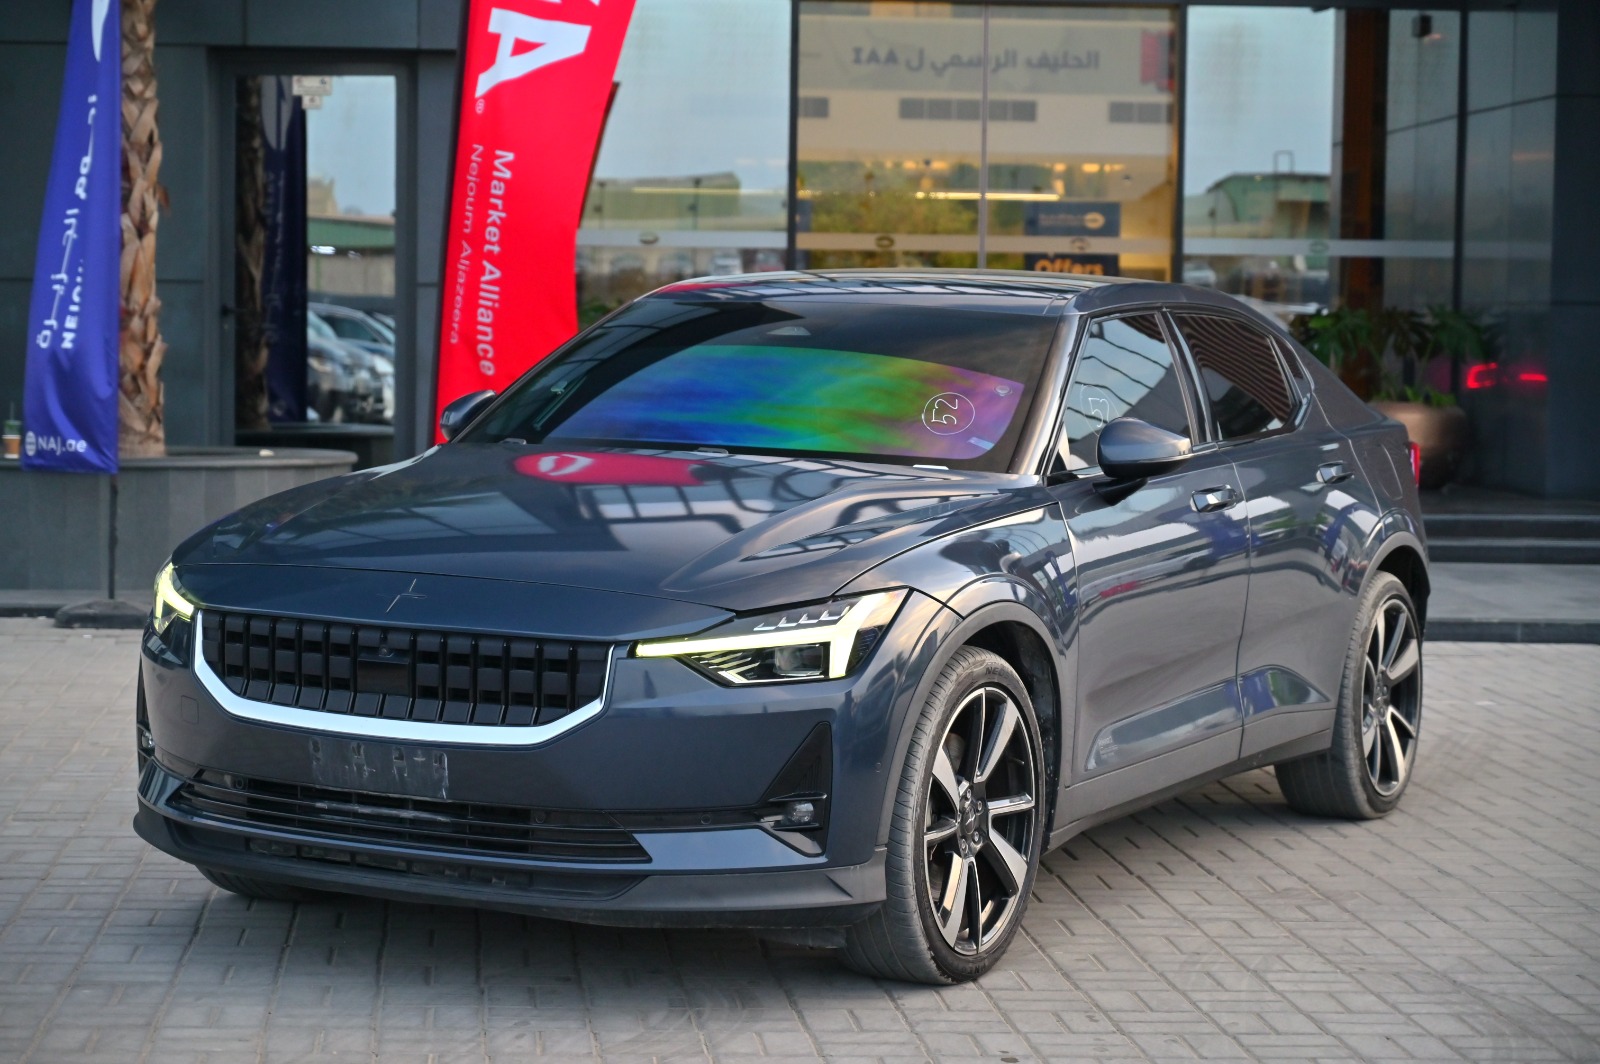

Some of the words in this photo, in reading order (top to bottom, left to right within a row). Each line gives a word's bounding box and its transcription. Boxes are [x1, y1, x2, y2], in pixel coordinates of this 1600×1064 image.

[852, 47, 899, 66] IAA
[463, 143, 484, 234] Nejoum
[483, 149, 515, 255] Market
[450, 239, 473, 344] Aljazeera
[476, 260, 502, 377] Alliance
[38, 435, 88, 456] NAJ.ae
[931, 398, 958, 425] 52
